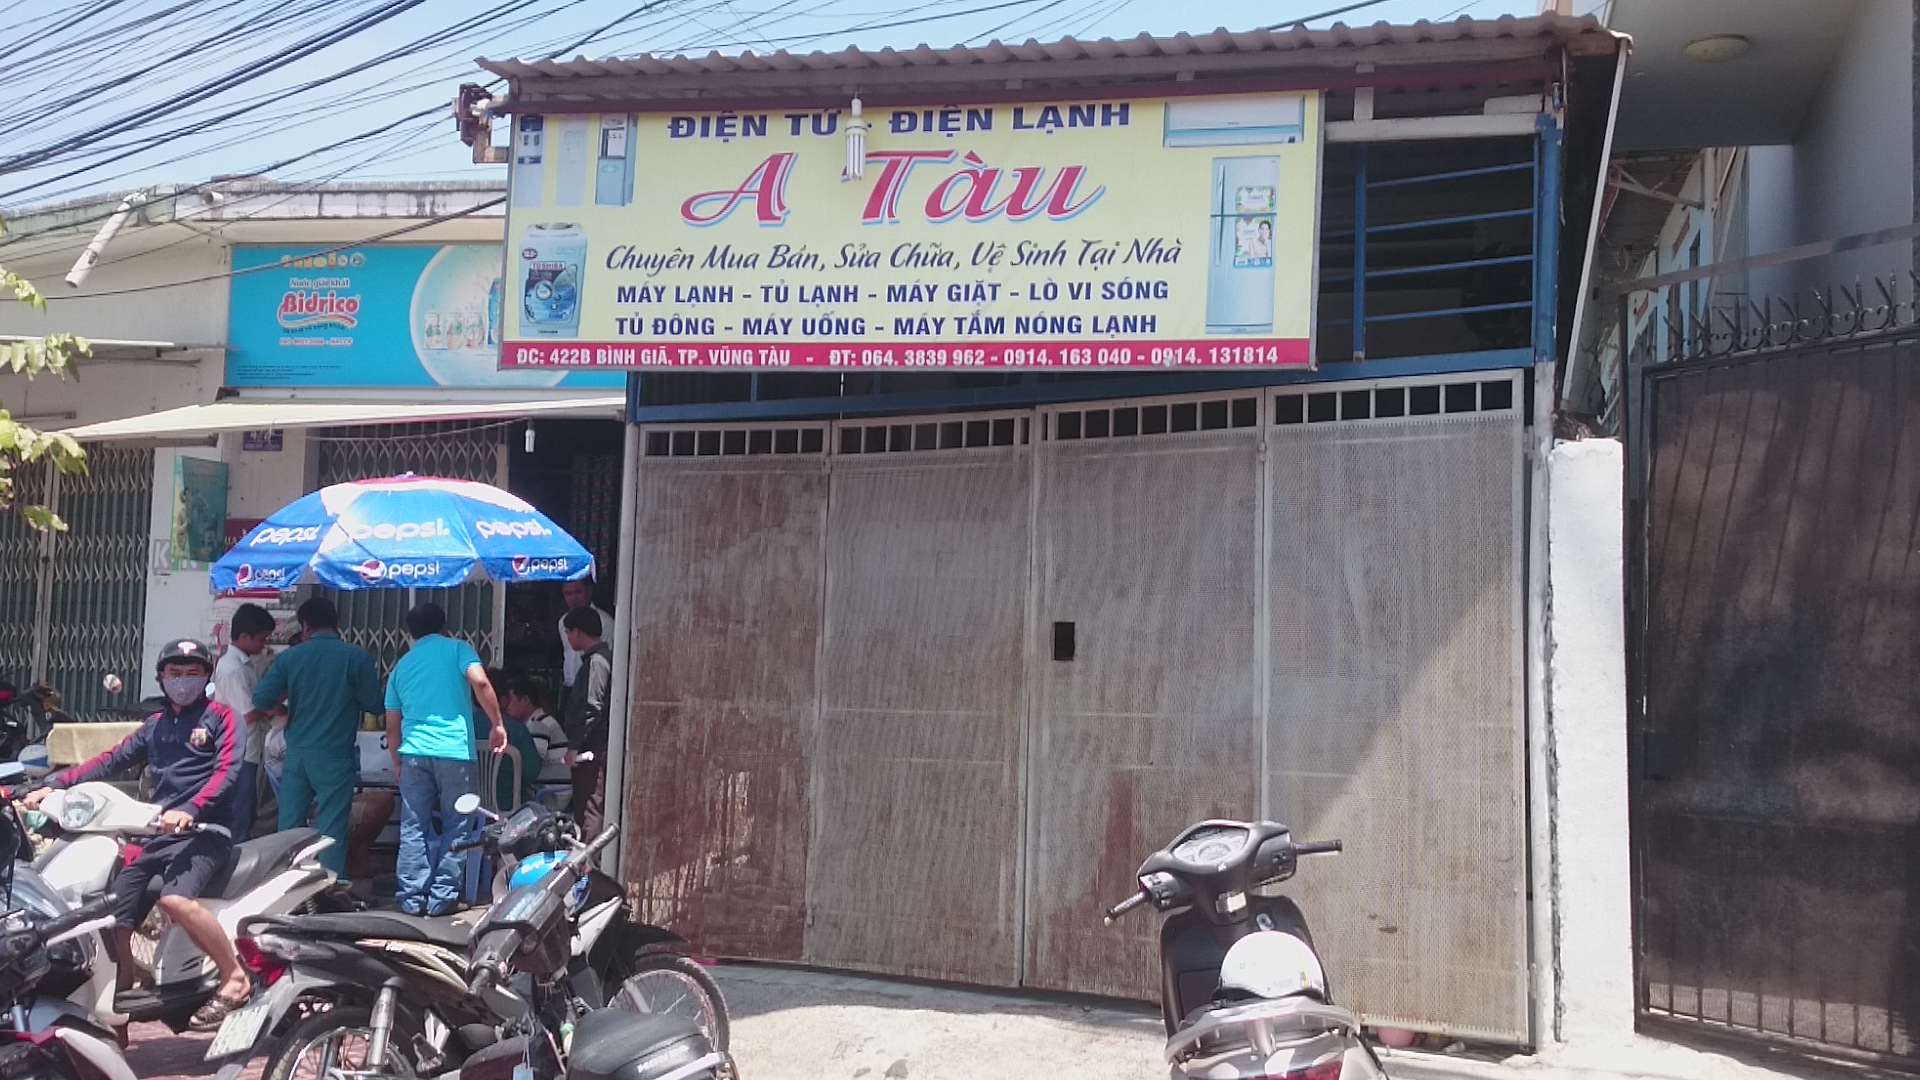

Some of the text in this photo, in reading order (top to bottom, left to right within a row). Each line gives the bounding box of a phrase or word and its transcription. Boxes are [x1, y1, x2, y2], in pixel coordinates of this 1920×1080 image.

[668, 110, 768, 142] ĐIỆN
[889, 104, 993, 137] ĐIỆN
[1012, 103, 1130, 134] LẠNH
[680, 149, 1105, 227] A Tàu
[606, 237, 1183, 277] Chuyên Mua Bán, Sửa Chữa, Vệ Sinh Tại Nhà
[282, 290, 358, 314] Bidrico
[616, 280, 666, 303] MÁY
[674, 285, 733, 308] LẠNH
[760, 279, 789, 303] TỦ
[798, 285, 858, 308] LẠNH
[886, 279, 938, 303] MÁY
[947, 279, 1001, 306] GIẶT
[1029, 277, 1058, 301] LÒ
[1068, 282, 1092, 301] VI
[1101, 276, 1168, 300] SÓNG
[615, 312, 643, 335] TỦ
[652, 312, 715, 335] ĐÔNG
[742, 313, 793, 335] MÁY
[802, 310, 865, 335] UỐNG
[894, 313, 945, 335] MÁY
[954, 309, 1005, 335] TẮM
[1015, 311, 1082, 334] NÓNG
[1092, 315, 1156, 338] LẠNH
[517, 348, 544, 364] ĐC:
[549, 348, 591, 364] 422B
[596, 345, 635, 364] BÌNH
[677, 349, 703, 365] TP.
[709, 346, 753, 365] VŨNG
[759, 346, 790, 365] TÀU
[829, 350, 856, 365] ĐT:
[862, 350, 899, 365] 064.
[904, 350, 947, 365] 3839
[952, 349, 985, 365] 962
[1004, 349, 1053, 365] 0914.
[1060, 348, 1091, 365] 163
[1098, 348, 1131, 365] 040
[1151, 348, 1201, 365] 0914.
[1209, 346, 1278, 364] 131814
[249, 523, 322, 547] pepsi
[348, 518, 449, 542] pepsi
[475, 518, 552, 540] pepsi
[253, 567, 286, 581] pepsi
[388, 560, 440, 579] pepsi
[530, 556, 568, 573] pepsi
